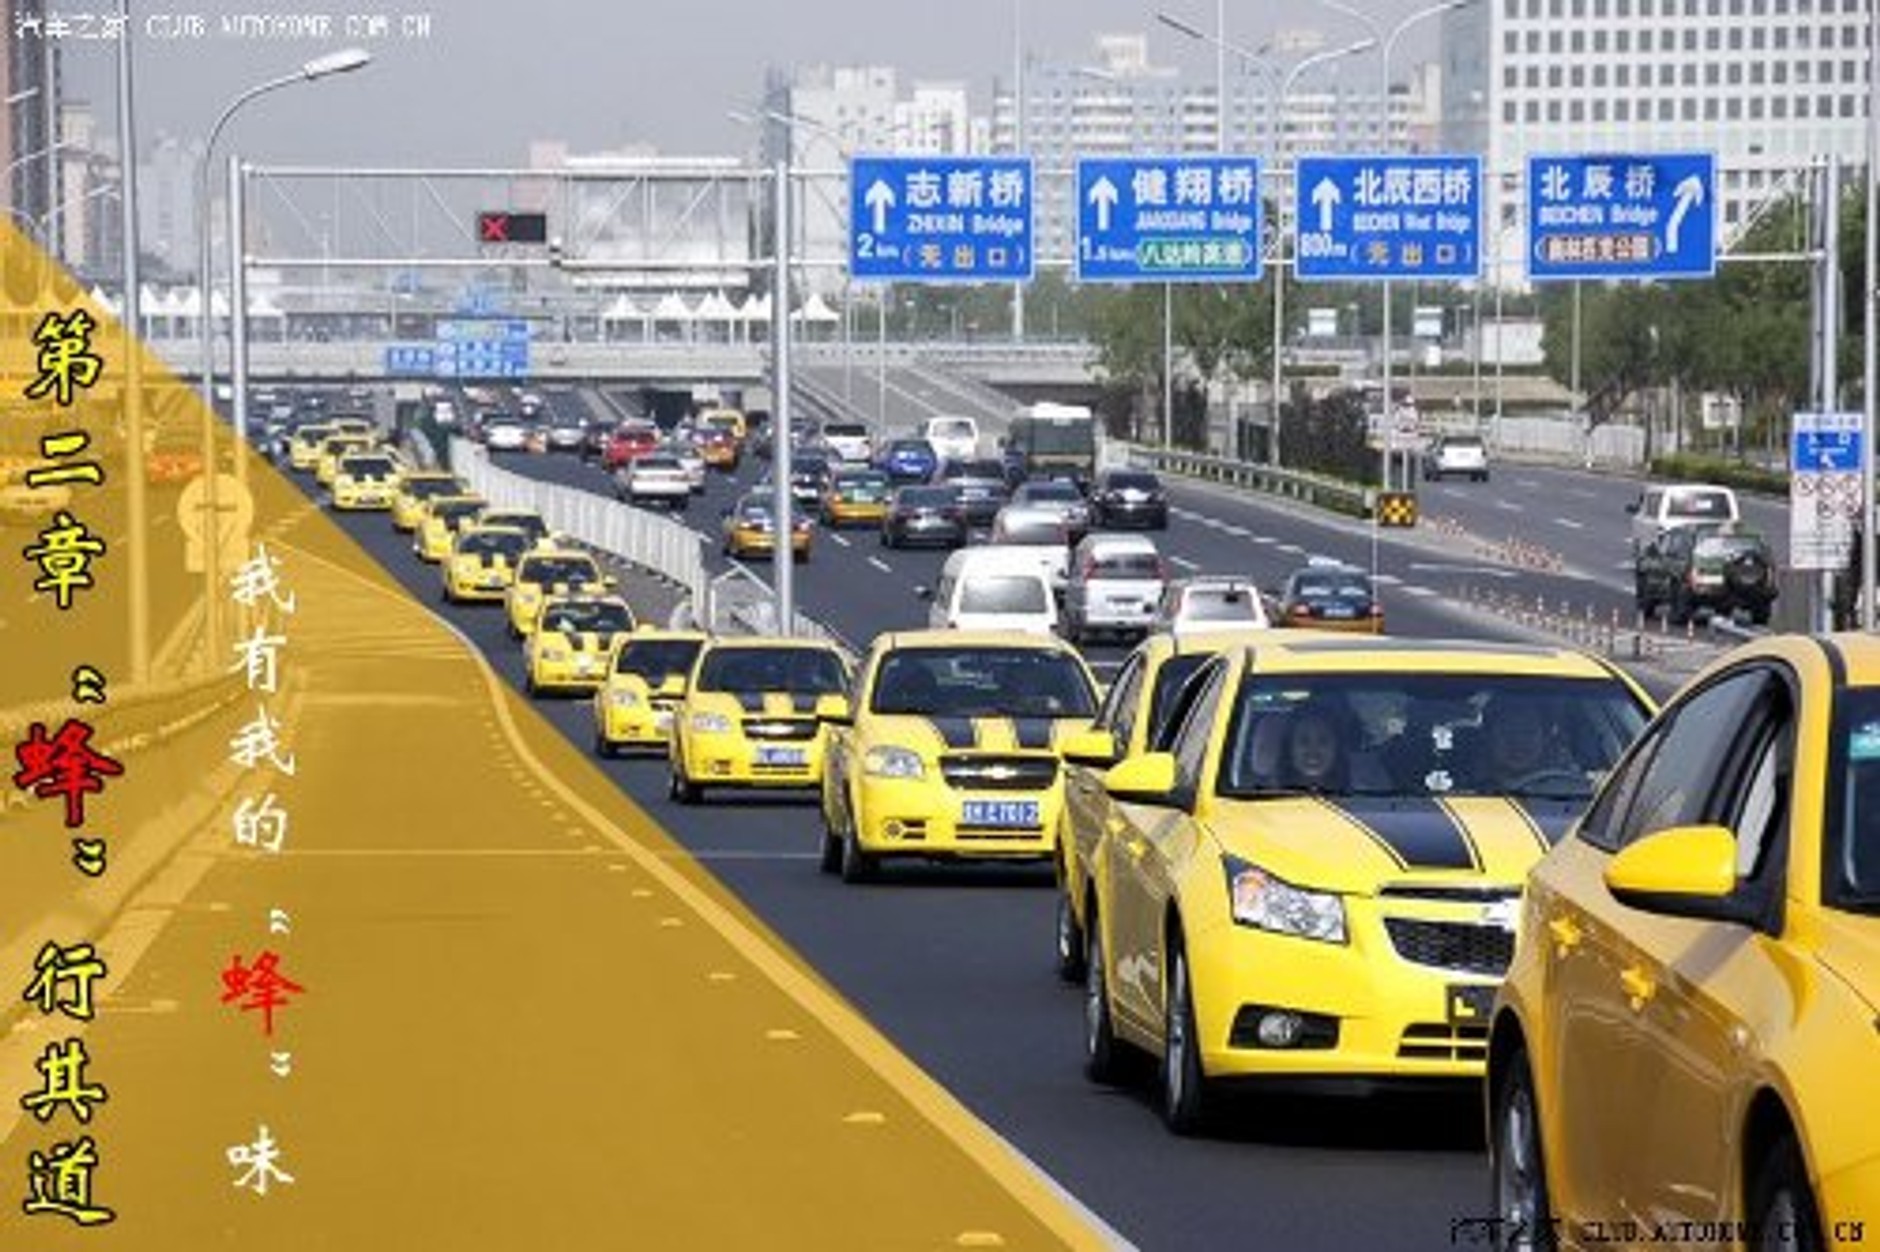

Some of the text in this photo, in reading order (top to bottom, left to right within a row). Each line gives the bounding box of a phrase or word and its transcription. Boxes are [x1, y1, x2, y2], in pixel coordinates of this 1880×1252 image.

[906, 169, 1024, 208] 志新桥
[1132, 167, 1253, 204] 健翔桥
[1353, 167, 1471, 205] 北辰西桥
[1541, 165, 1655, 200] 北辰桥
[973, 213, 1024, 237] Bridge
[1211, 210, 1252, 234] Bridge
[1436, 211, 1471, 235] Bridge
[1610, 203, 1658, 227] Bridge
